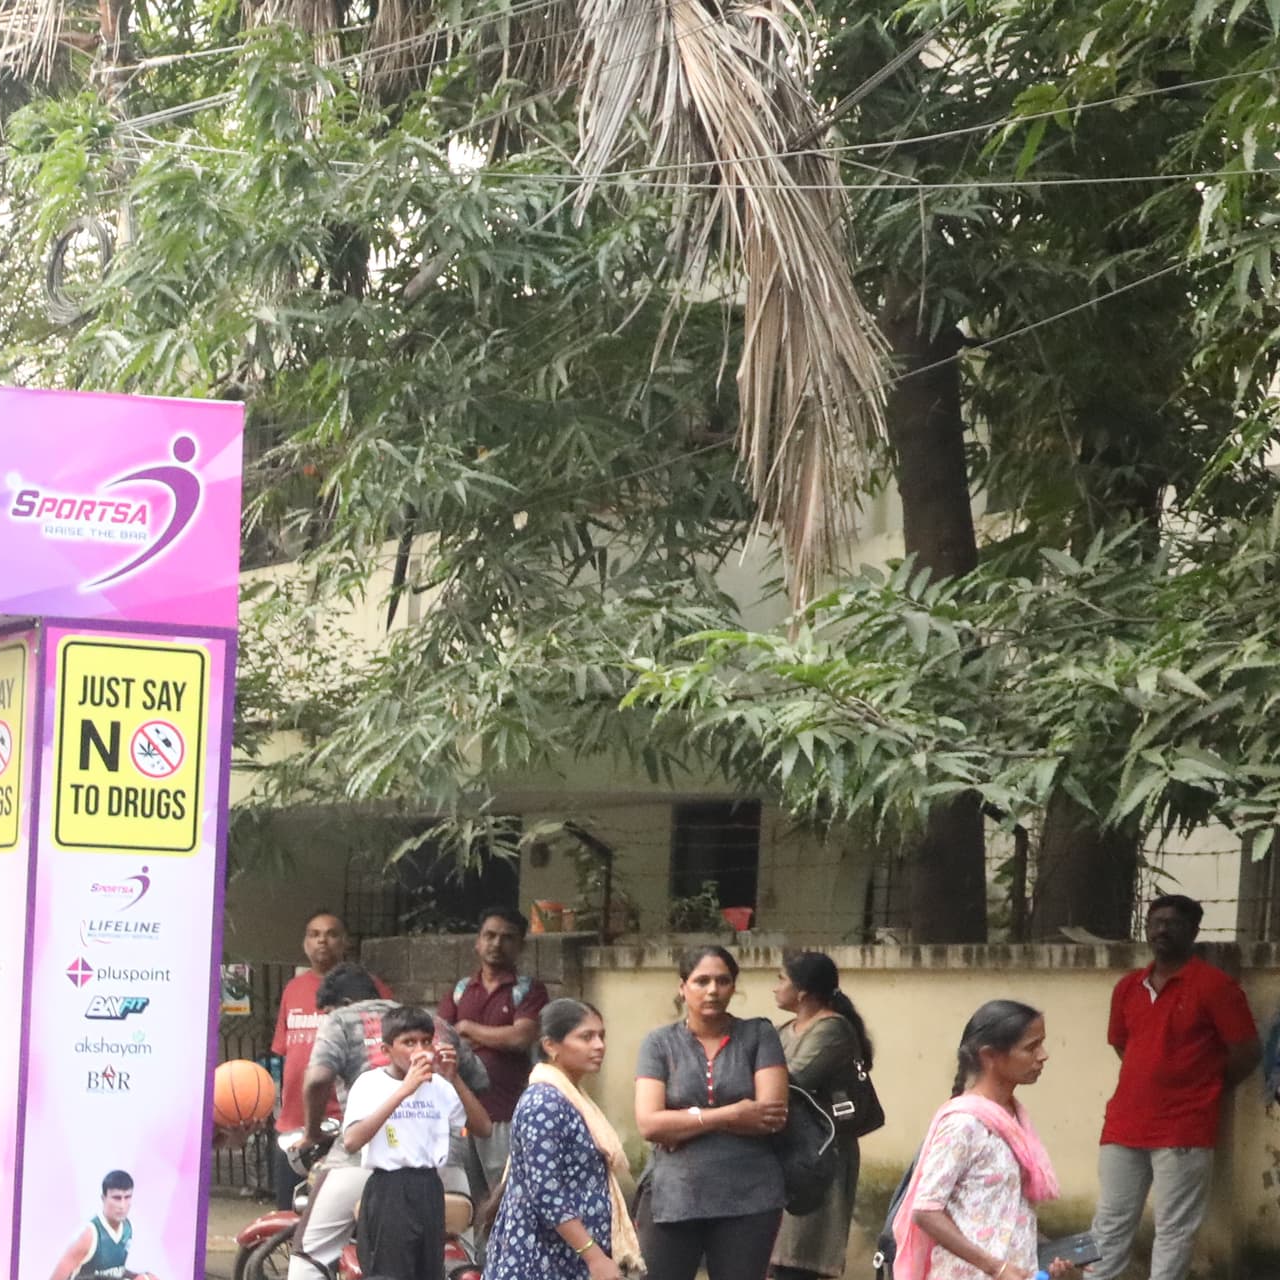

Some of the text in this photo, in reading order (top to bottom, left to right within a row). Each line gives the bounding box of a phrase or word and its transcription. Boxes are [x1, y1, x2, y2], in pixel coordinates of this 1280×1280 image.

[12, 489, 147, 526] SPORTSA
[78, 675, 187, 712] JUST SAY
[70, 784, 186, 821] TO DRUGS
[89, 920, 161, 934] LIFELINE
[97, 965, 171, 983] pluspoint
[74, 1037, 152, 1057] akshayam
[87, 1070, 131, 1091] BNR
